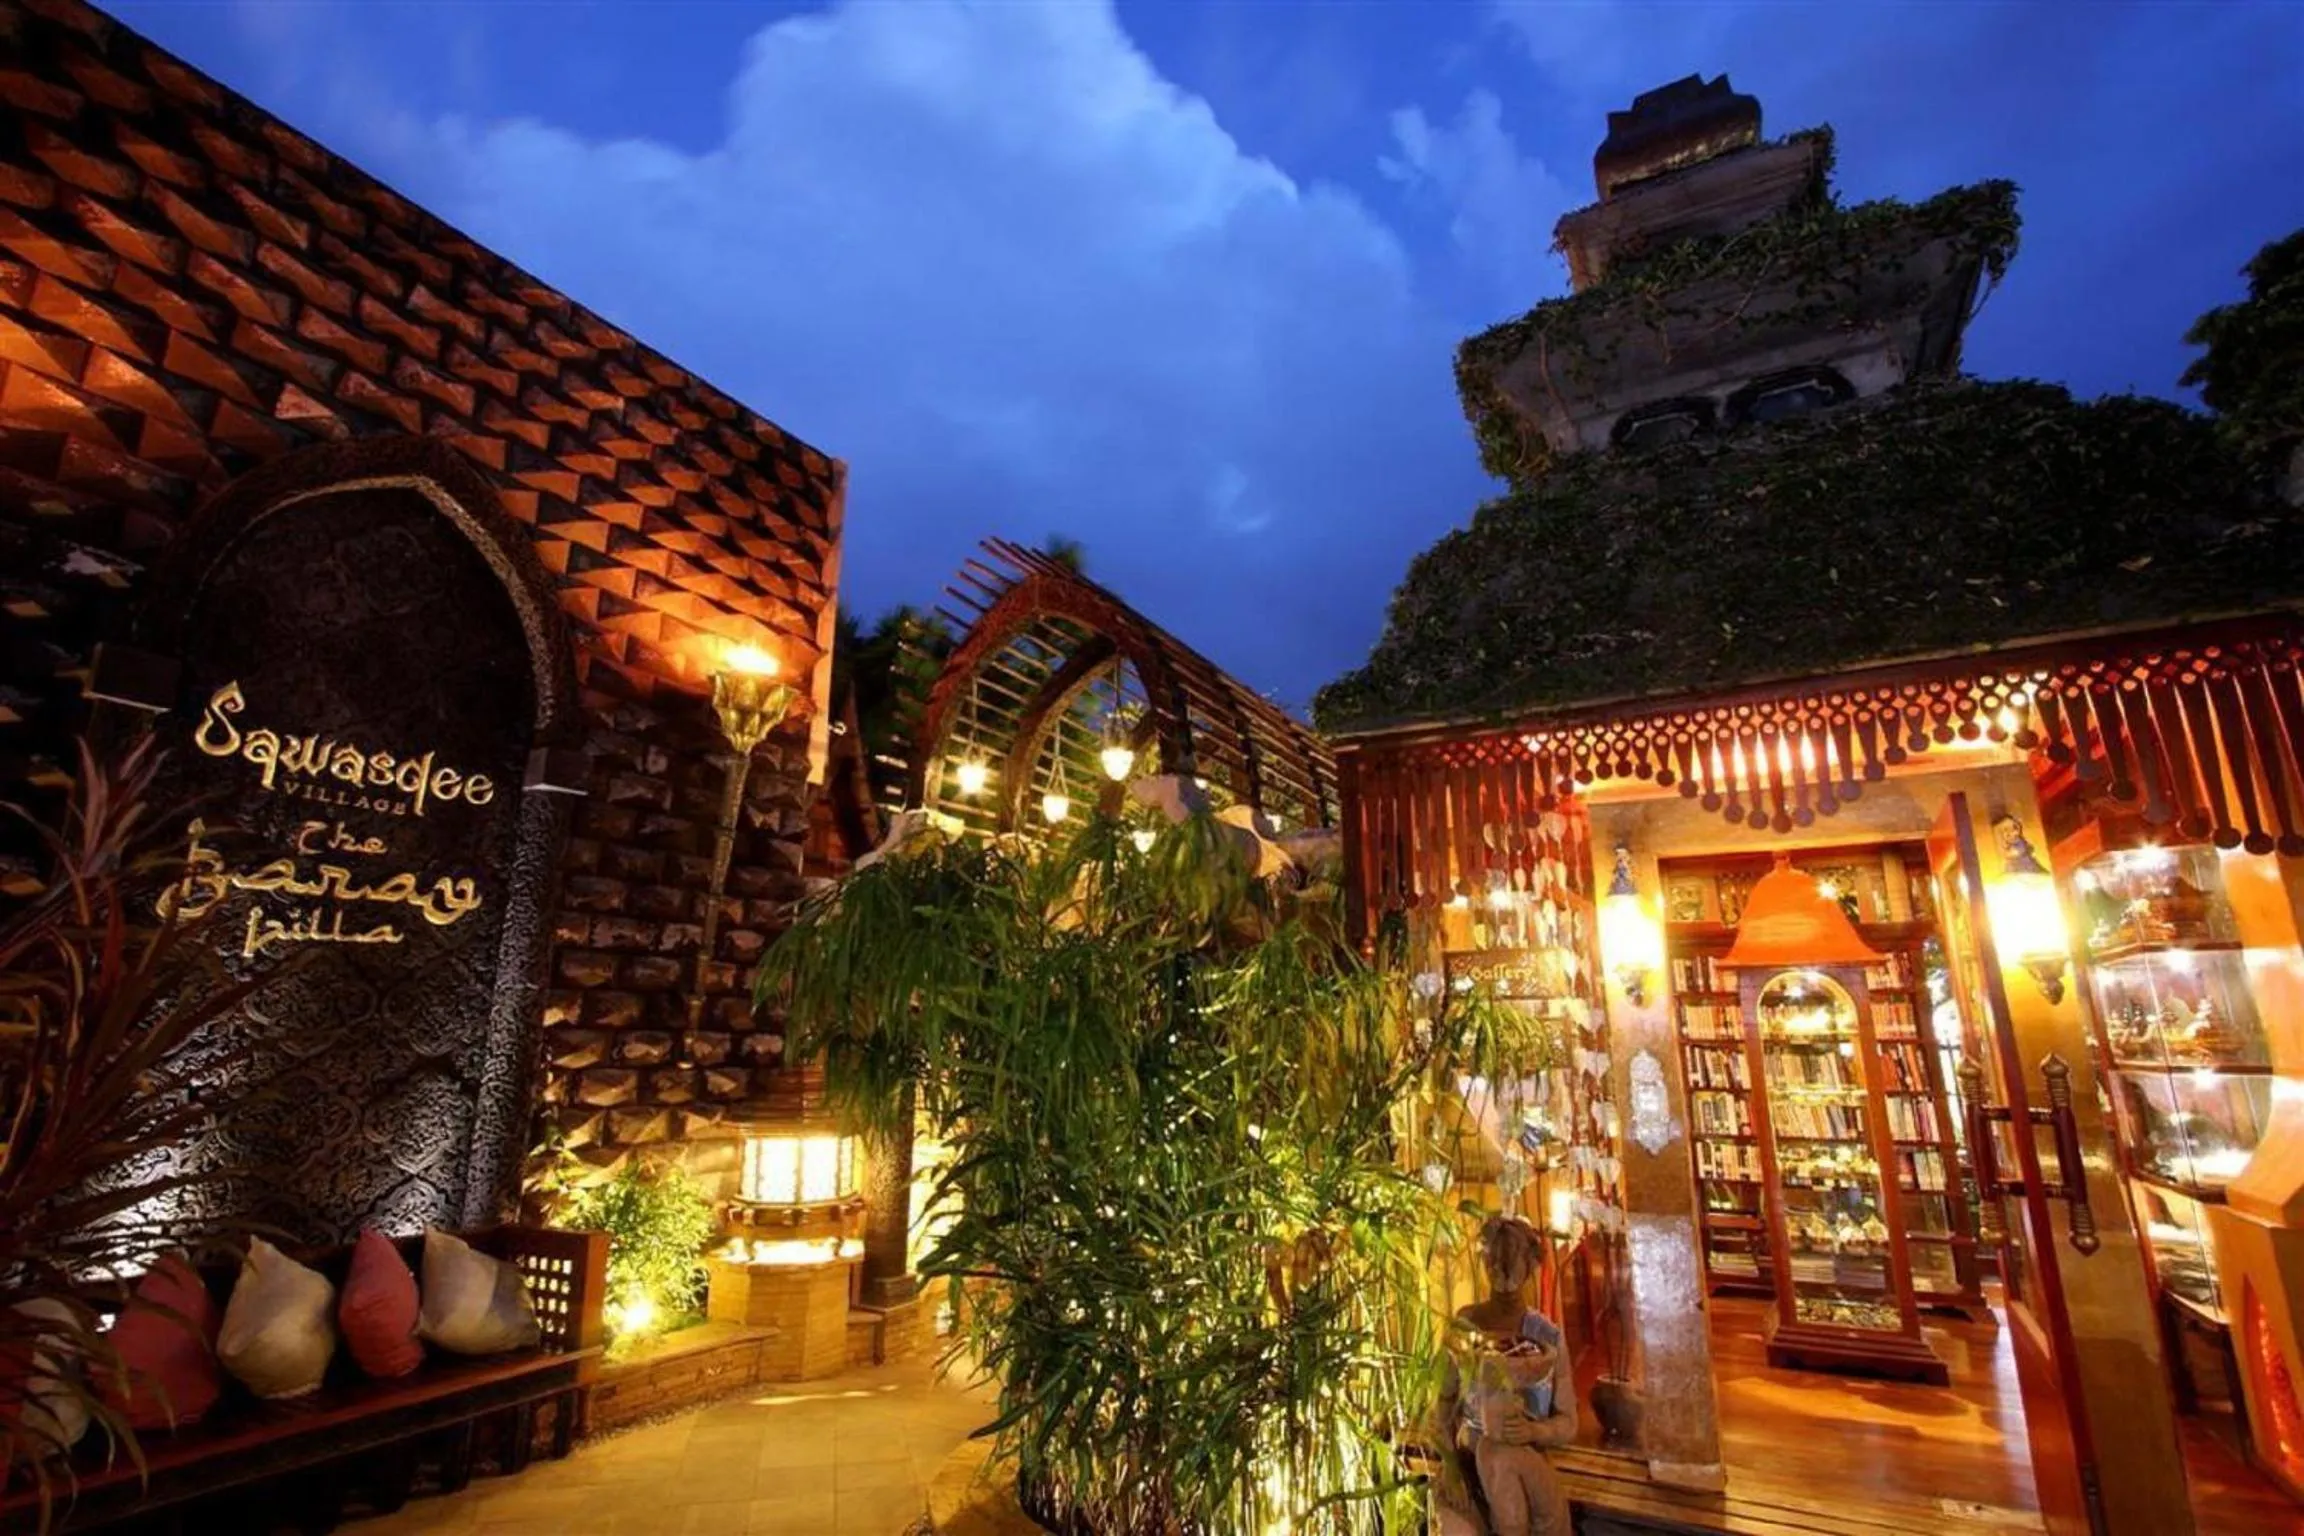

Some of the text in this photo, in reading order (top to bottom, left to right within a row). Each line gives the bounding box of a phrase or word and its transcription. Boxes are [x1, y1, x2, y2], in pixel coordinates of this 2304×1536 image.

[195, 680, 494, 816] Sawasdee
[283, 781, 407, 815] VILLAGE
[155, 817, 482, 926] Baray
[300, 821, 390, 855] The
